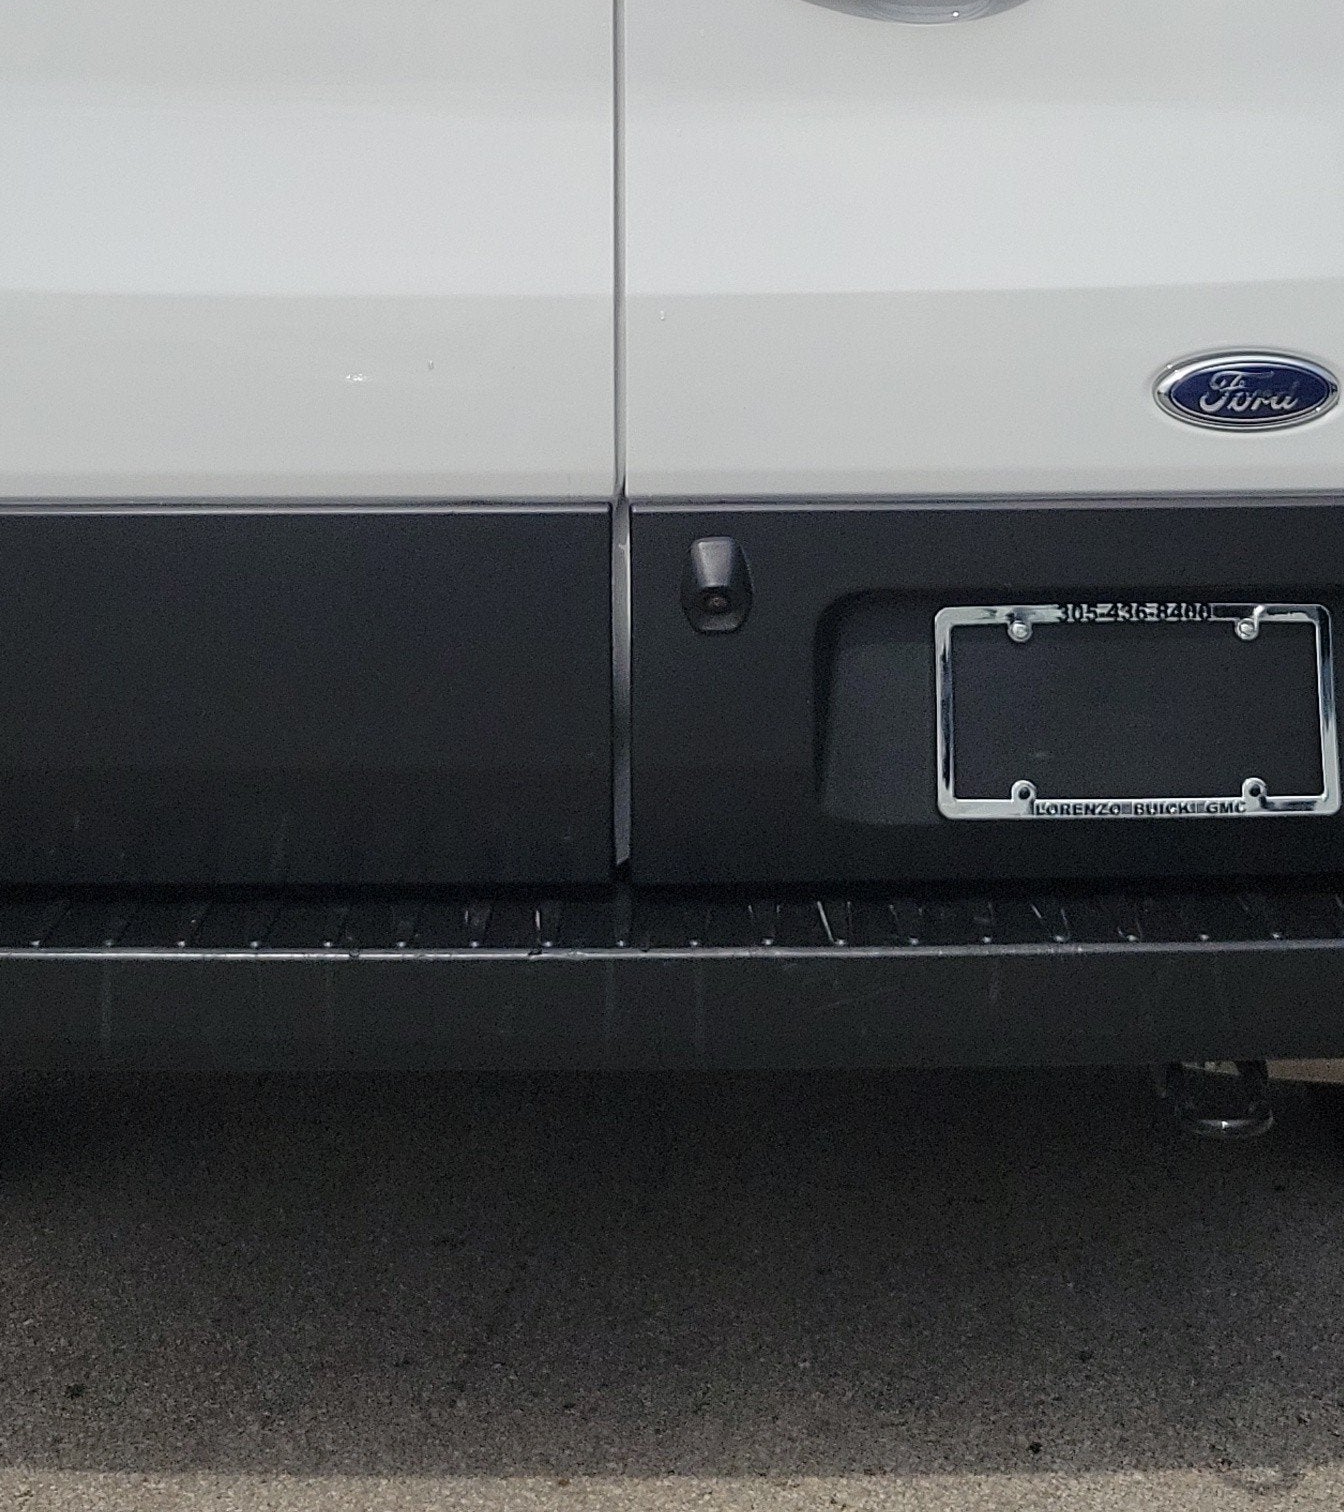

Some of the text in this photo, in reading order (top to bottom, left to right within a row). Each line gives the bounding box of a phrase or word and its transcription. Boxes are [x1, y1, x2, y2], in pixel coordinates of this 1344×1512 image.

[1199, 370, 1300, 413] Ford
[1057, 602, 1212, 622] 305-436-8400
[1035, 800, 1247, 816] LORENZO BUICK GMC
